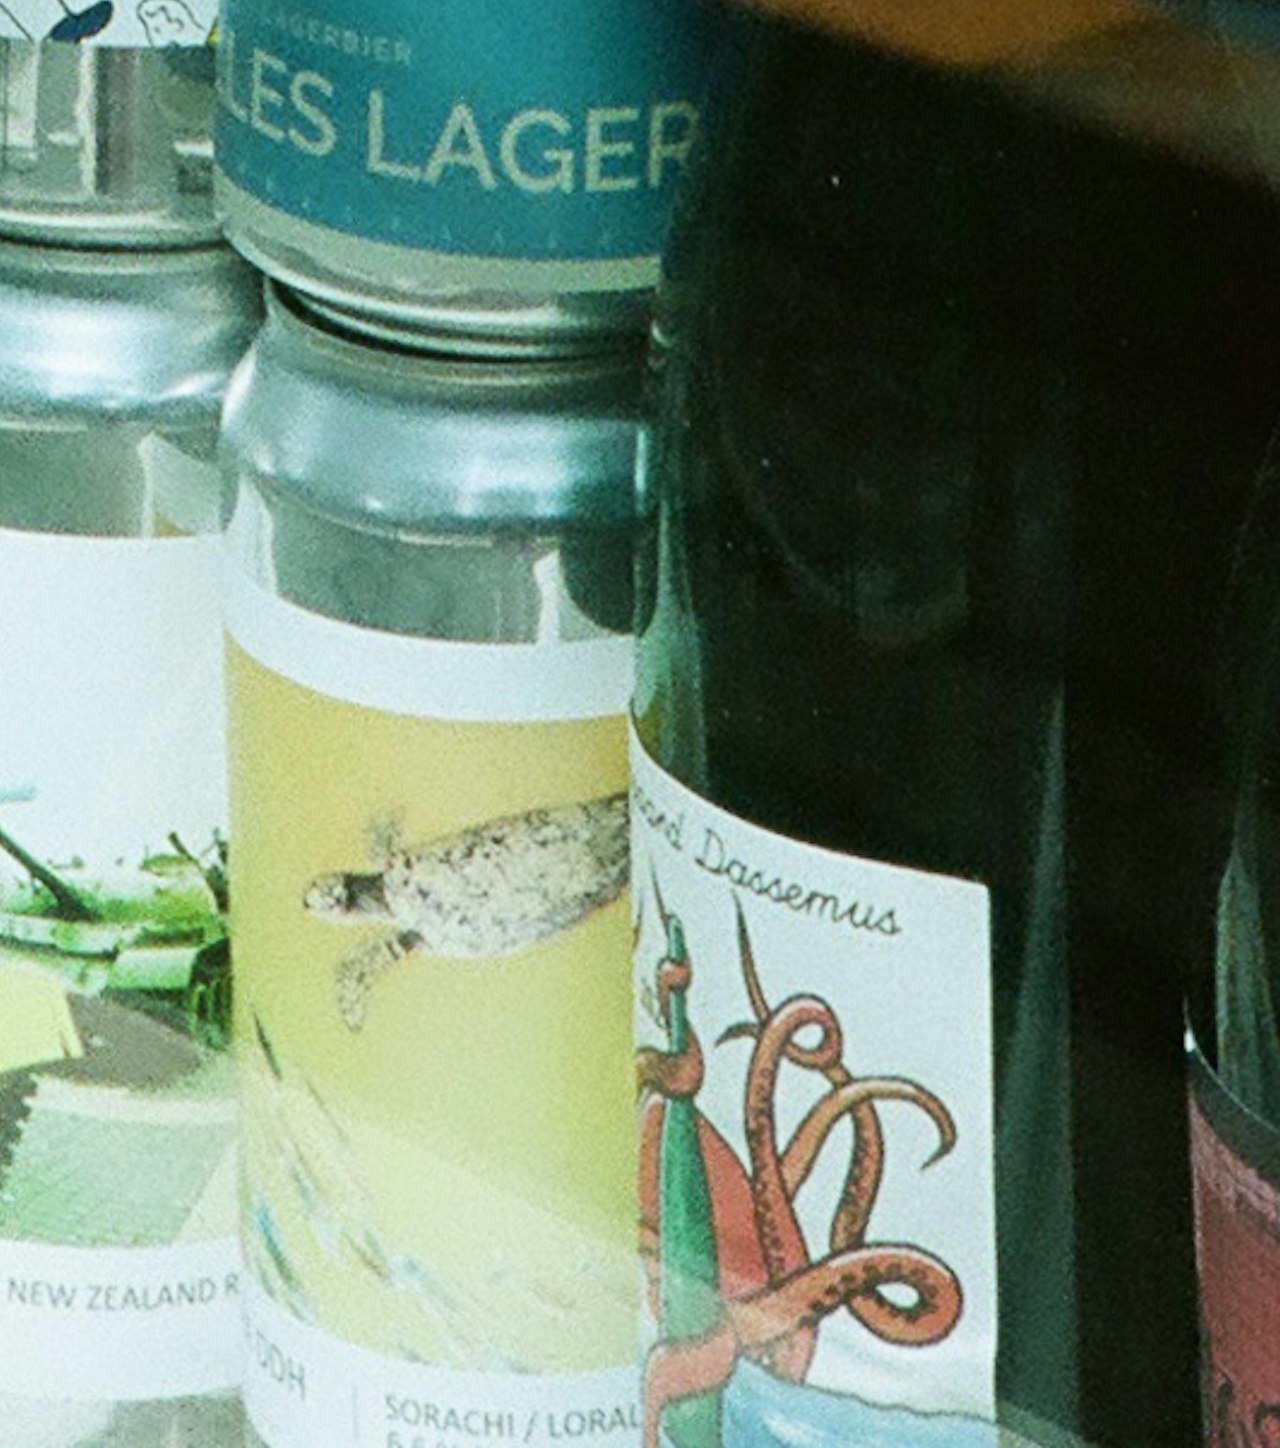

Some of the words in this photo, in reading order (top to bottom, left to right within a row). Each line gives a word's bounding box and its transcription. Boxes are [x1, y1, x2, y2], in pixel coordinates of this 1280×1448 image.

[693, 827, 902, 936] Dassemus
[7, 1276, 78, 1310] NEW
[86, 1273, 218, 1312] ZEALAND
[383, 1392, 518, 1439] SORACHI
